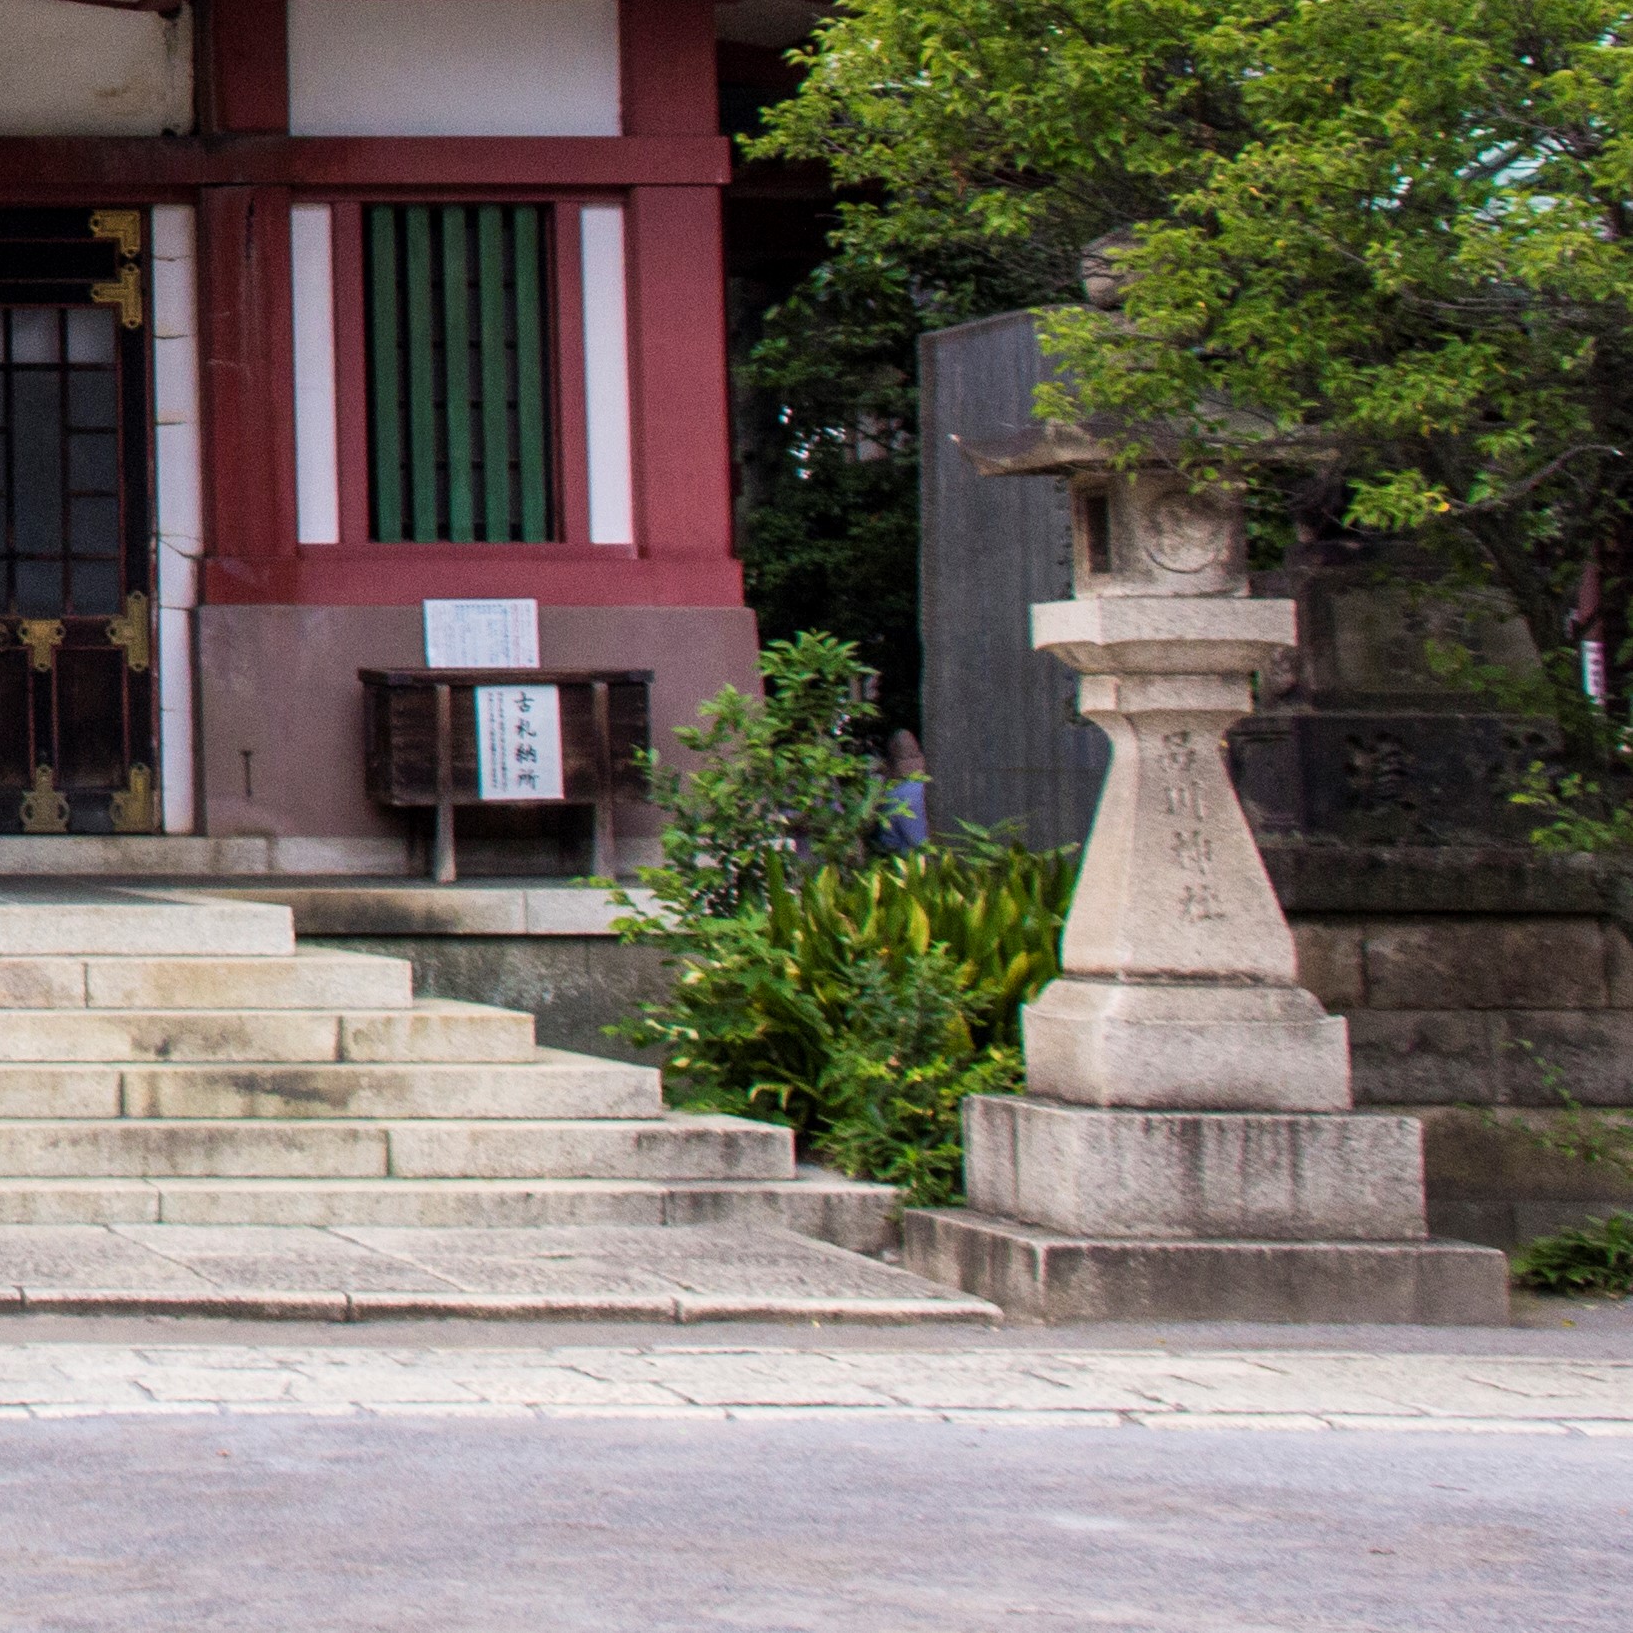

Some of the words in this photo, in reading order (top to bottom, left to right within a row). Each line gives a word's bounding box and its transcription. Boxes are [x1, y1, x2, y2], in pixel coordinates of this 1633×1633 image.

[513, 691, 540, 790] 古札納所
[1156, 729, 1227, 923] 品川神社
